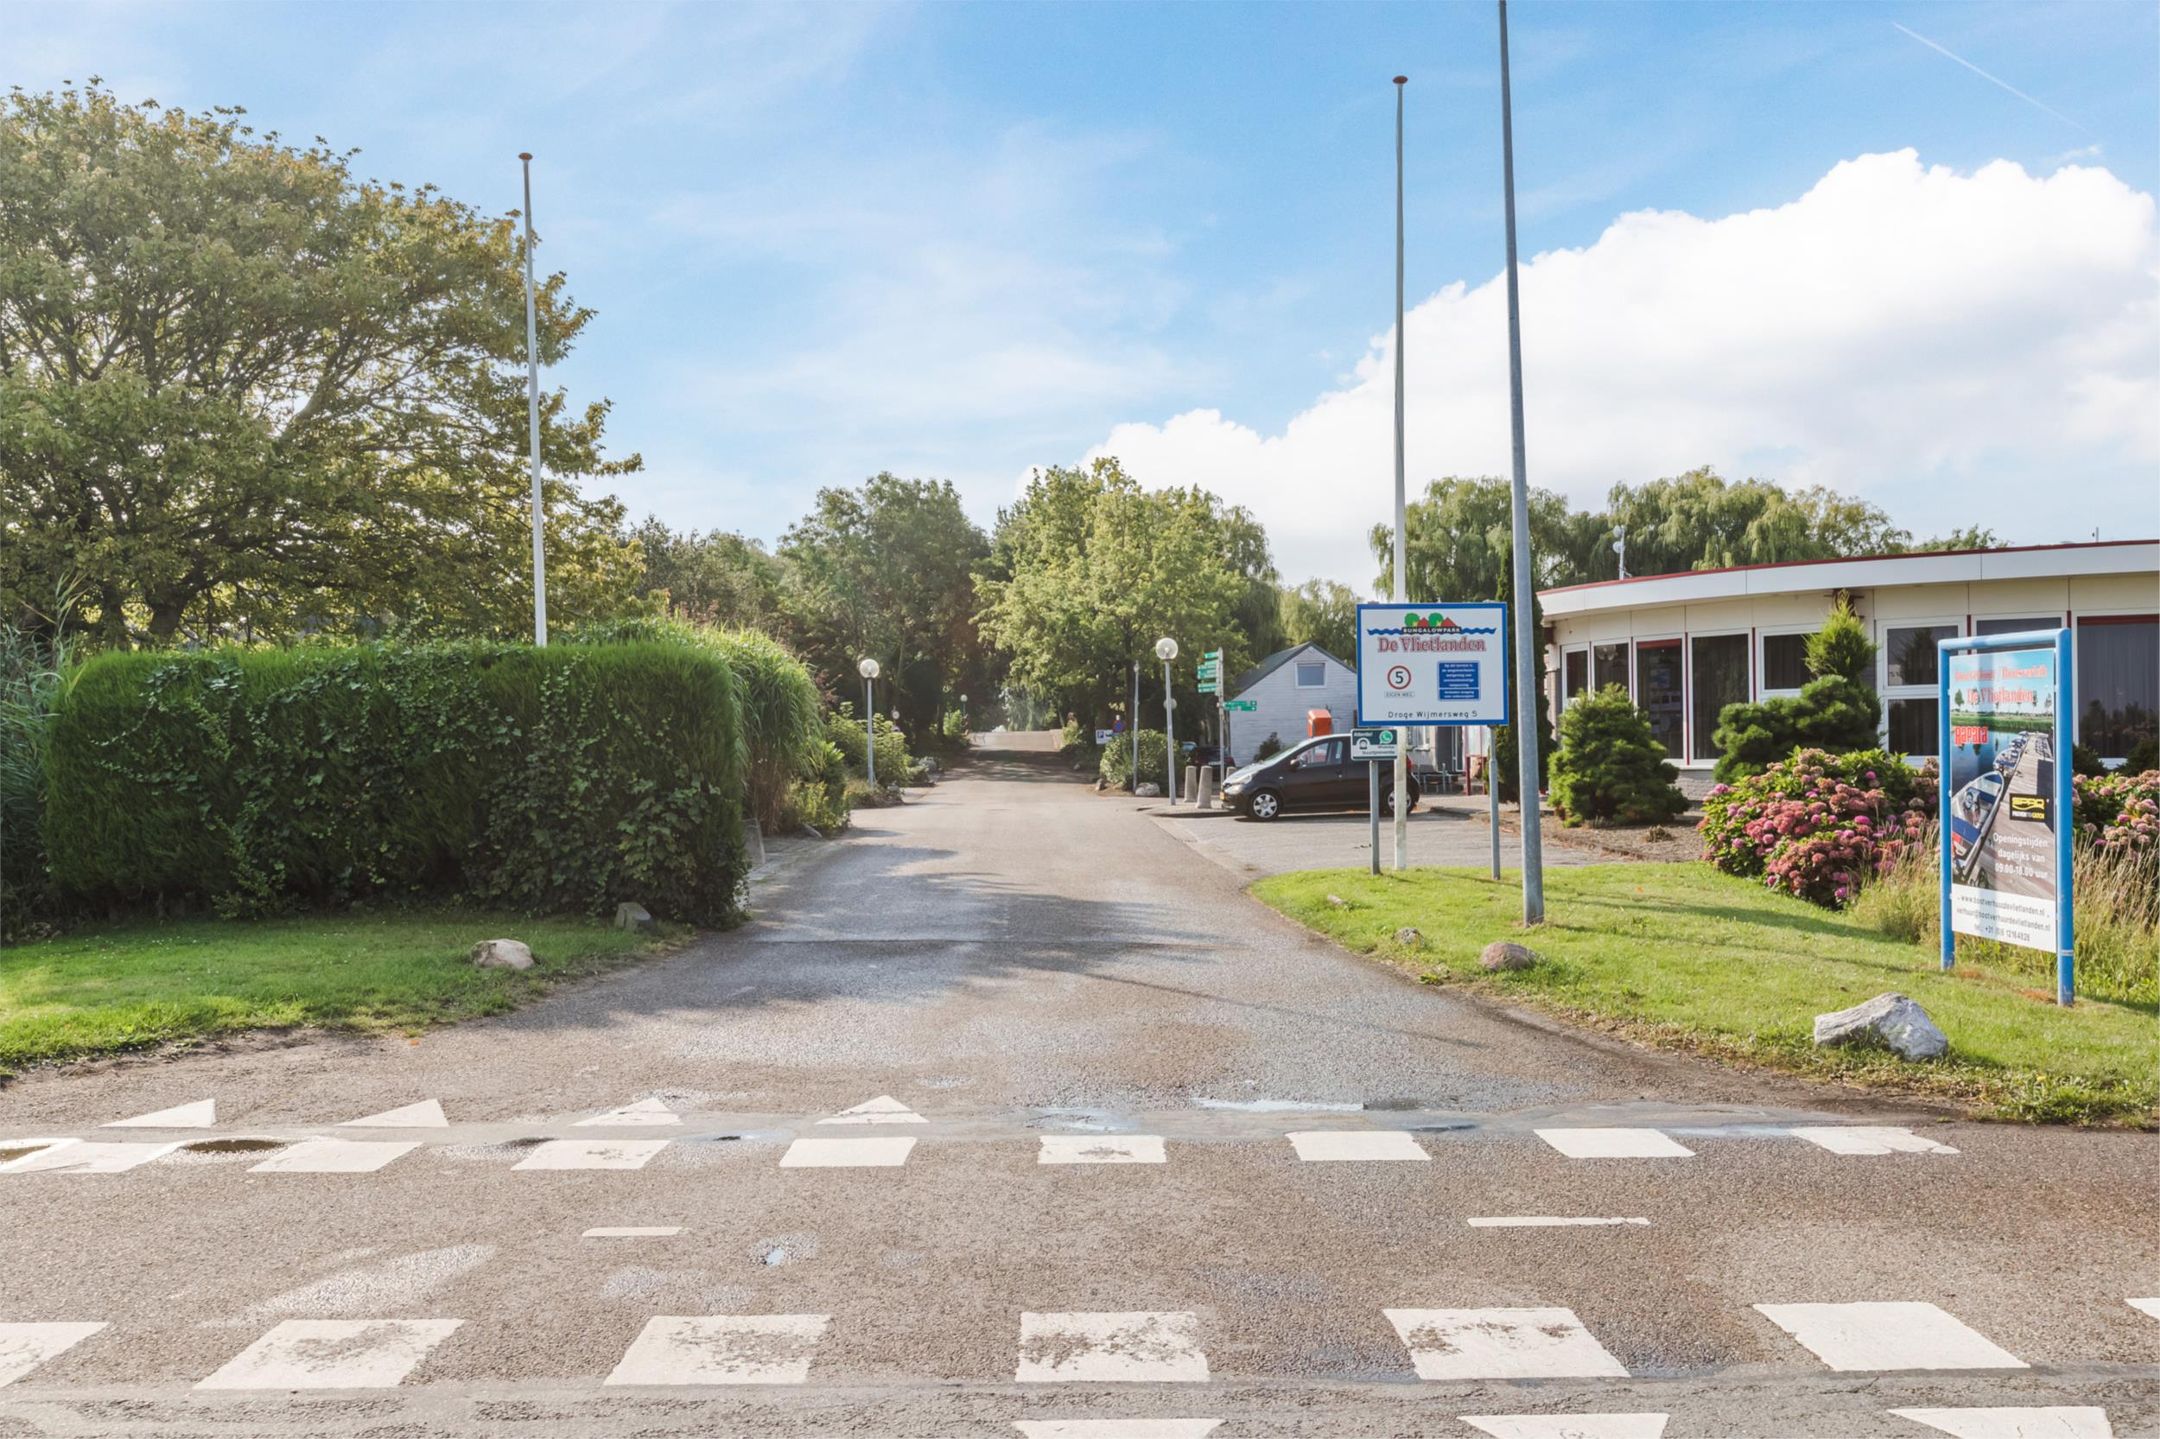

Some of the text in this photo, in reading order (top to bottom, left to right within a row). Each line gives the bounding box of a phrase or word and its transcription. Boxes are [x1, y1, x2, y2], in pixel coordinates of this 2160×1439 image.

[1378, 636, 1486, 653] De Vlietlanden
[1395, 671, 1404, 684] 5
[1388, 711, 1413, 719] Droge
[1416, 711, 1469, 719] Wijmersweg
[1998, 849, 2045, 862] dagelijks van
